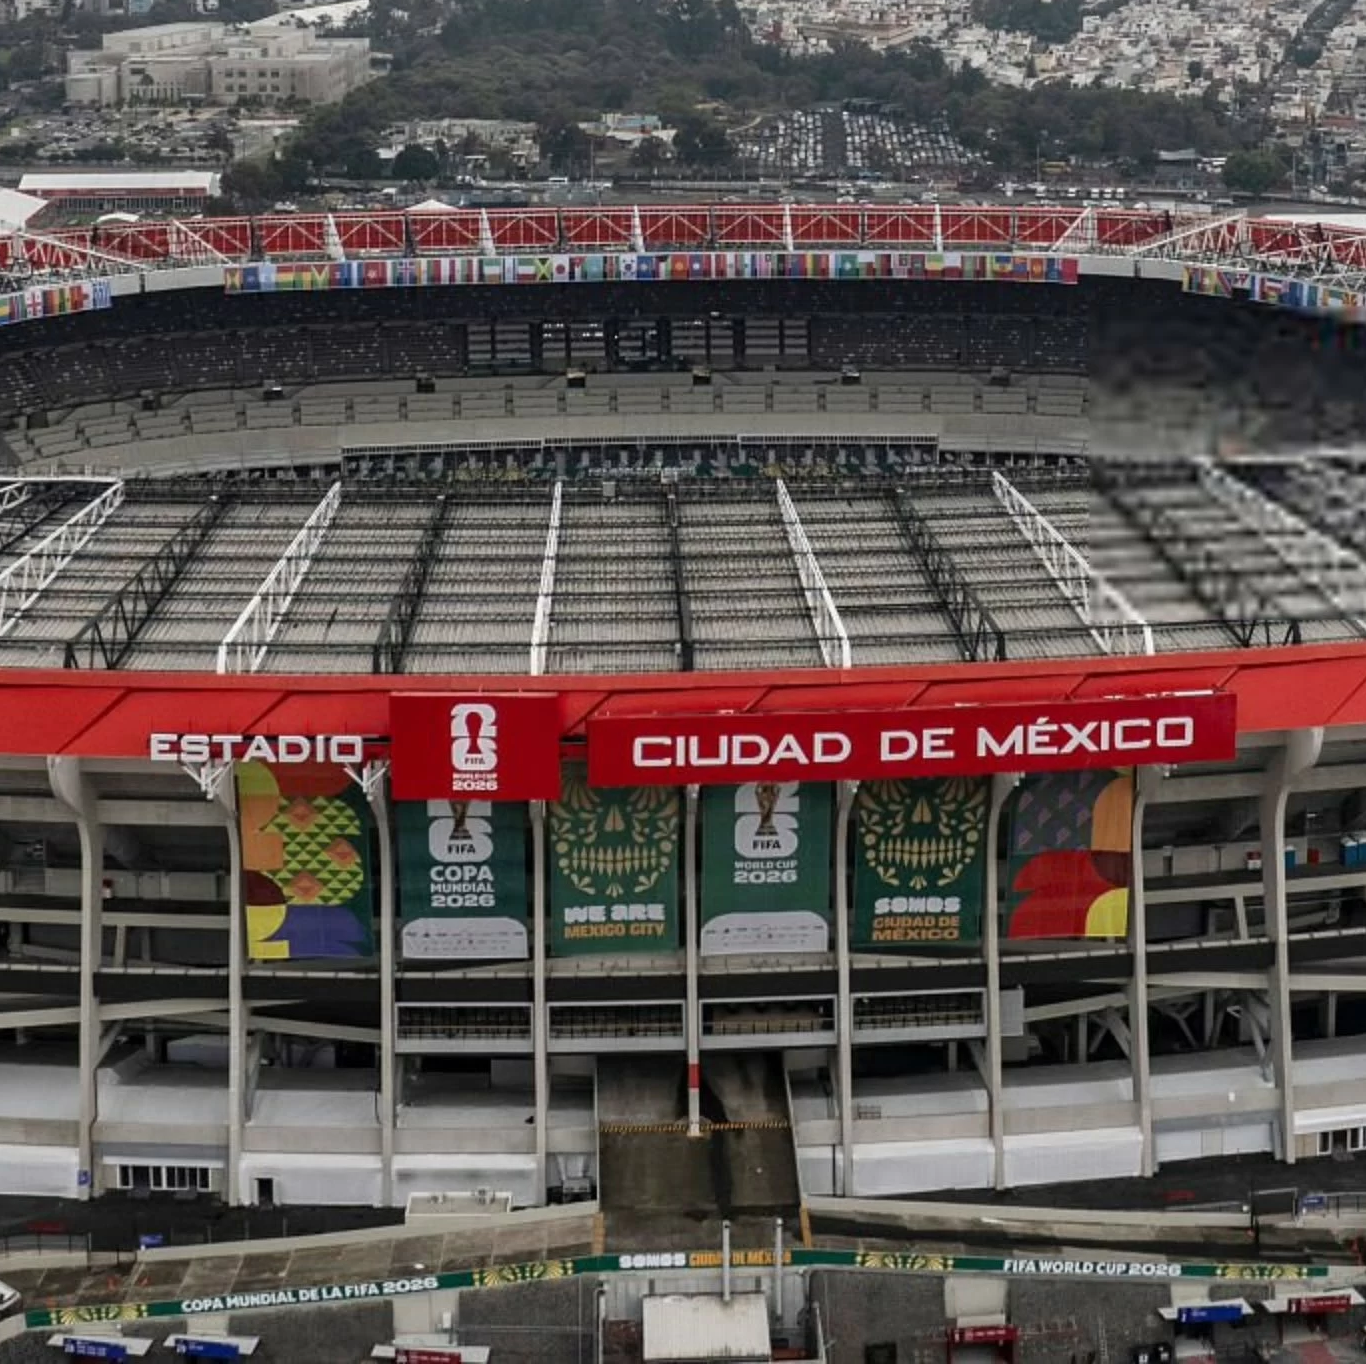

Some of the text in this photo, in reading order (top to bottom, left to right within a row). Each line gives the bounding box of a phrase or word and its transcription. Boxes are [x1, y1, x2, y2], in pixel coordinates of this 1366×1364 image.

[151, 733, 363, 763] ESTADIO
[632, 716, 1194, 767] CIUDAD DE MÉXICO
[452, 779, 498, 791] 2026
[447, 844, 476, 854] FIFA
[752, 840, 781, 849] FIFA
[734, 859, 798, 869] WORLD CUP
[430, 865, 494, 882] COPA
[734, 870, 798, 884] 2026
[430, 882, 495, 893] MUNDIAL
[431, 894, 496, 908] 2026
[874, 896, 961, 915] SOMOS
[564, 905, 607, 925] WE
[874, 915, 960, 928] CIUDAD DE
[564, 922, 665, 939] MEXICO CITY
[1003, 1259, 1182, 1277] FIFA WORLD CUP 2026
[181, 1277, 438, 1313] COPA MUNDIAL DE LA FIFA 2026
